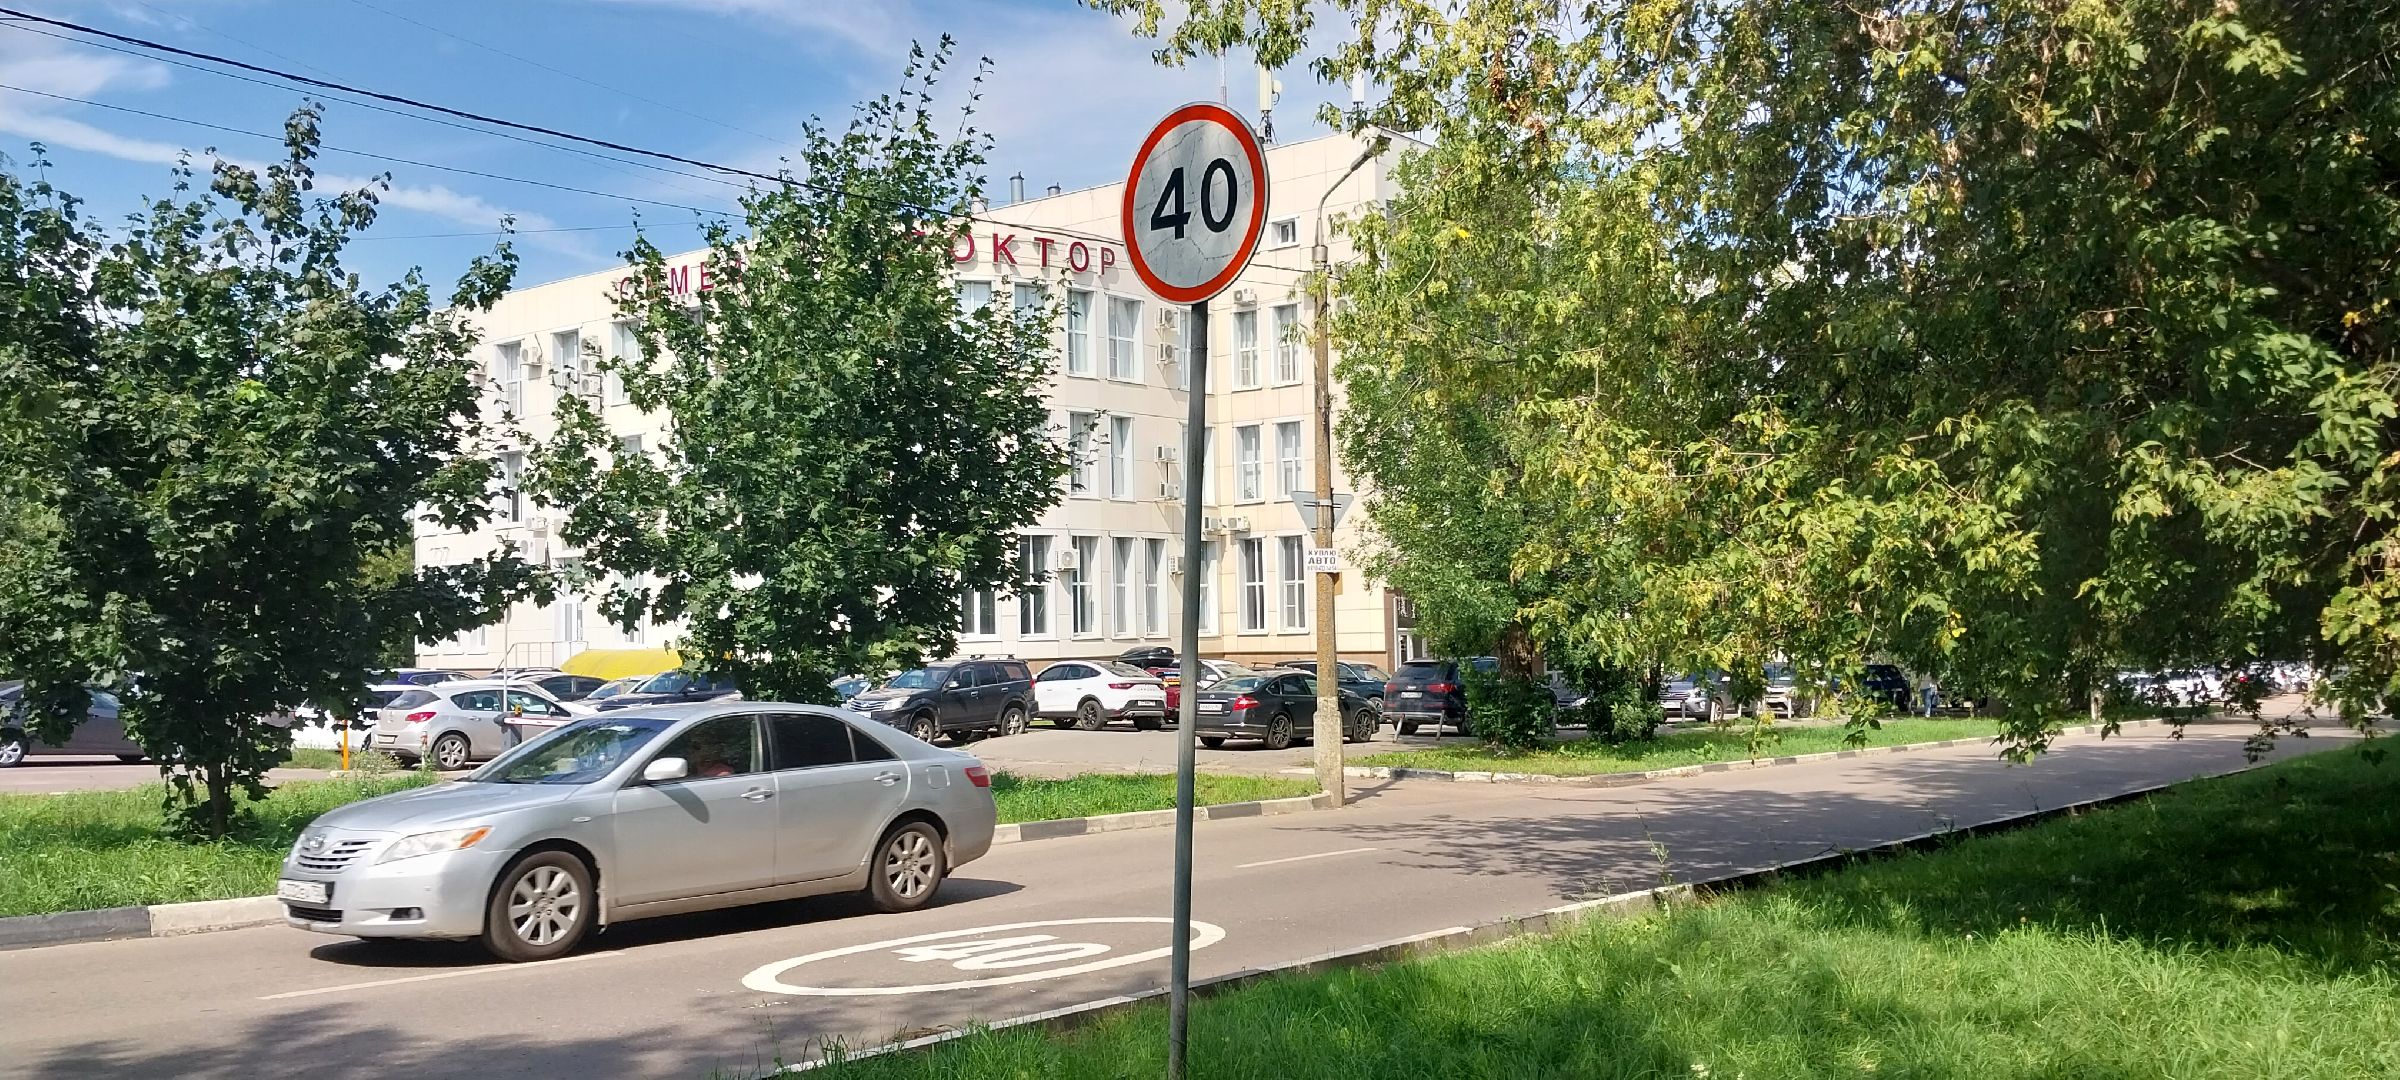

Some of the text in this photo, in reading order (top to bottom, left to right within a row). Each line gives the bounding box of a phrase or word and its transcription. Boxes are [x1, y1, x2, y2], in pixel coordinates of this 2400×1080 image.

[1150, 157, 1238, 240] 40
[906, 228, 1116, 276] ОКТОР
[1308, 556, 1336, 565] АВТО
[890, 934, 1112, 971] 40
